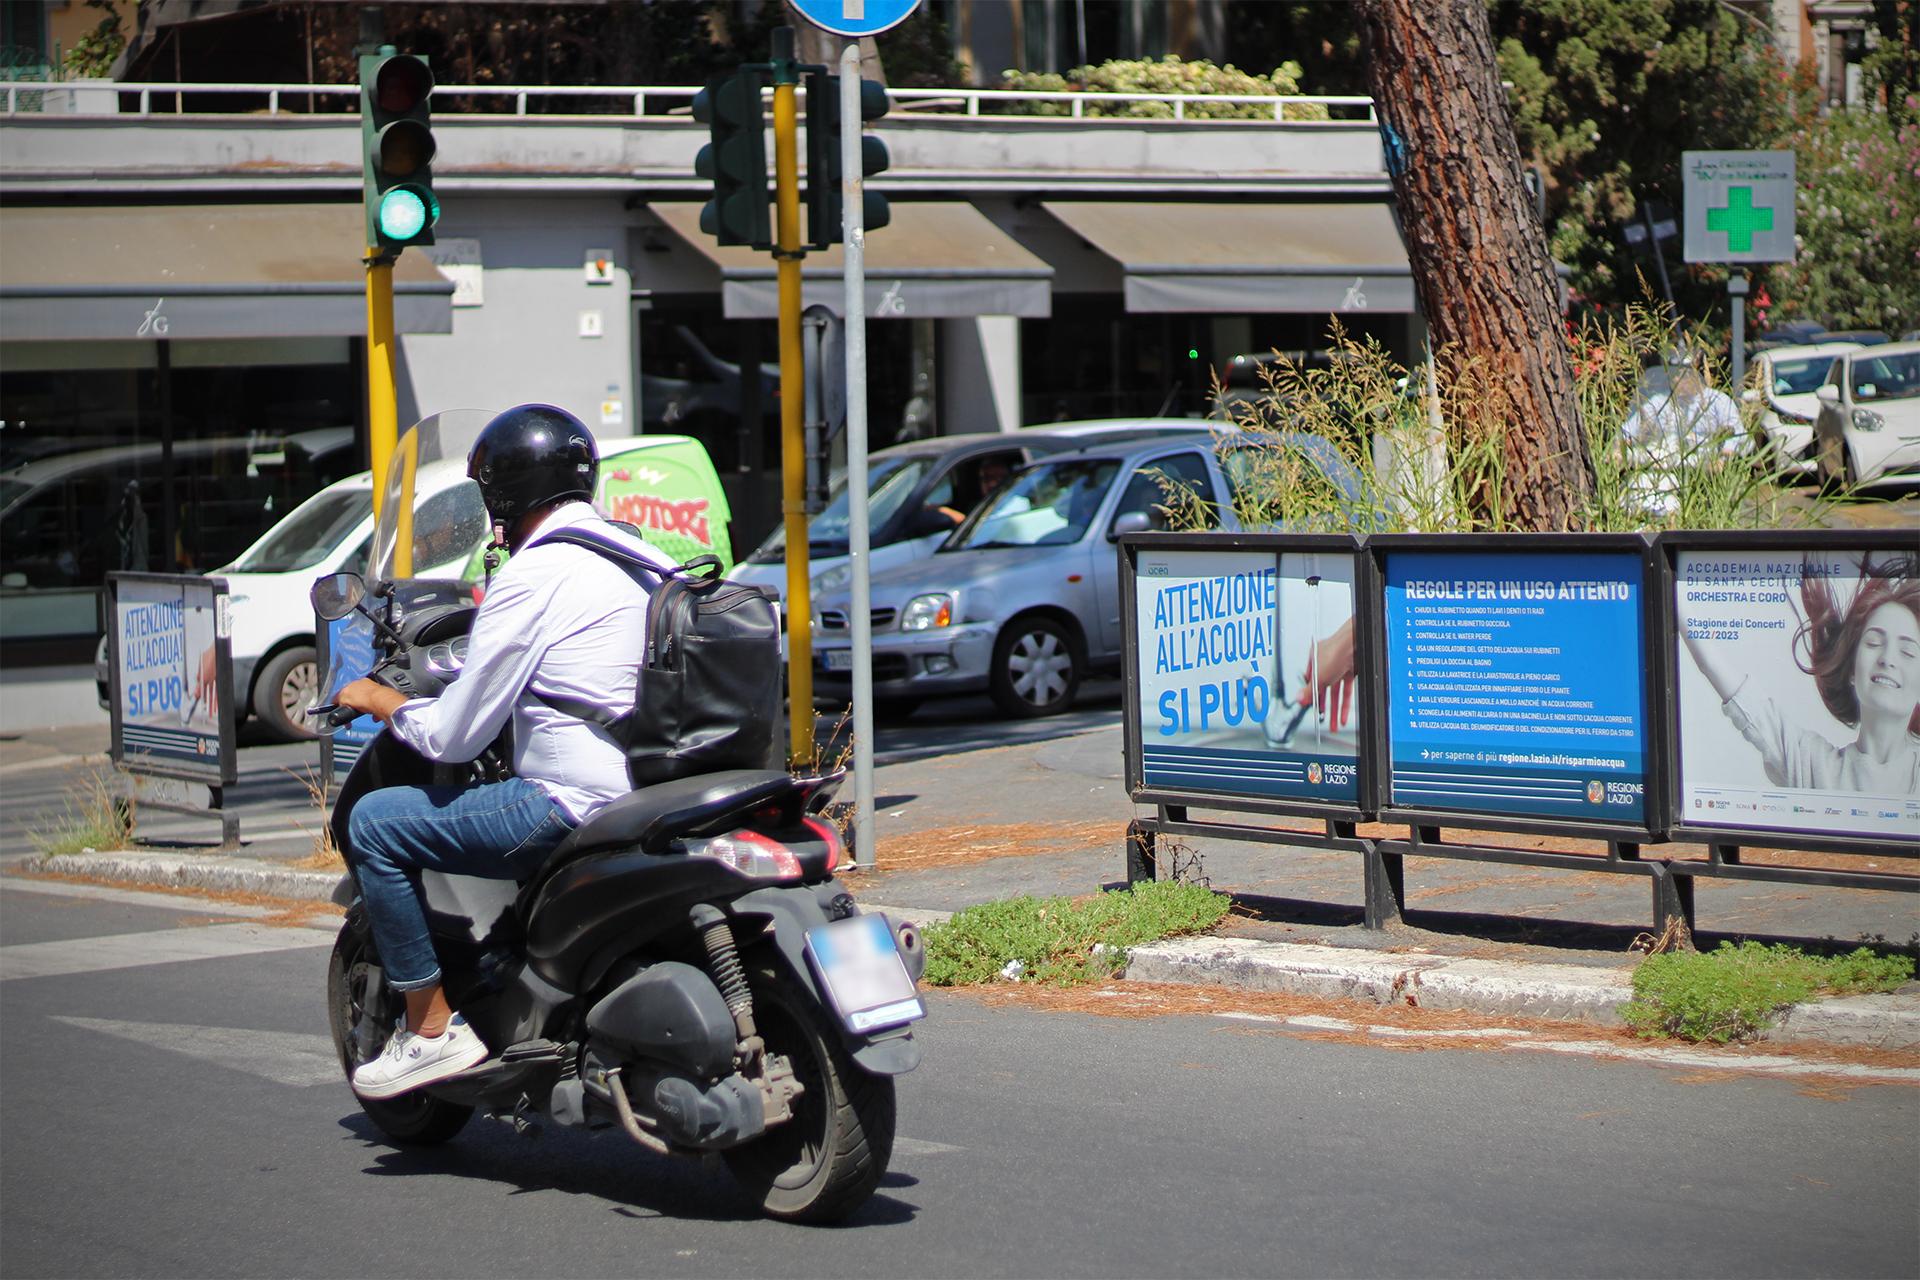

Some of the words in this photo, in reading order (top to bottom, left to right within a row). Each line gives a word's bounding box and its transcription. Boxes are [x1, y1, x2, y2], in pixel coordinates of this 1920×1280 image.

[1687, 563, 1761, 574] ACCADEMIA
[1766, 563, 1841, 575] NAZIONALE
[1687, 576, 1699, 587] DI
[1705, 576, 1745, 587] SANTA
[1751, 577, 1802, 588] CECILIA
[1405, 581, 1464, 599] REGOLE
[1467, 581, 1497, 599] PER
[1499, 581, 1521, 600] UN
[1524, 581, 1556, 600] USO
[1558, 581, 1629, 600] ATTENTO
[1154, 567, 1277, 630] ATTENZIONE
[1687, 591, 1747, 602] ORCHESTRA
[1750, 592, 1756, 602] E
[1758, 592, 1786, 603] CORO
[125, 597, 184, 641] ATTENZIONE
[1415, 619, 1444, 627] CONTROLLA
[1687, 618, 1728, 630] Stagione
[1729, 618, 1744, 629] dei
[1745, 619, 1786, 629] Concerti
[1687, 630, 1739, 640] 2022/2023
[1156, 614, 1273, 675] ALL'ACQUA!
[126, 631, 184, 672] ALL'ACQUA!
[128, 679, 144, 717] SI
[147, 665, 183, 715] PUÒ
[1408, 682, 1414, 690] 7.
[1158, 688, 1190, 738] SI
[1199, 660, 1270, 732] PUÒ
[1431, 751, 1443, 761] per
[1445, 751, 1475, 762] saperne
[1476, 751, 1484, 761] di
[1486, 752, 1497, 763] più
[1498, 752, 1626, 769] regione.lazio.it/risparmioacqua
[1324, 764, 1357, 776] REGIONE
[1325, 774, 1348, 785] LAZIO
[1608, 781, 1644, 794] REGIONE
[1608, 793, 1634, 804] LAZIO
